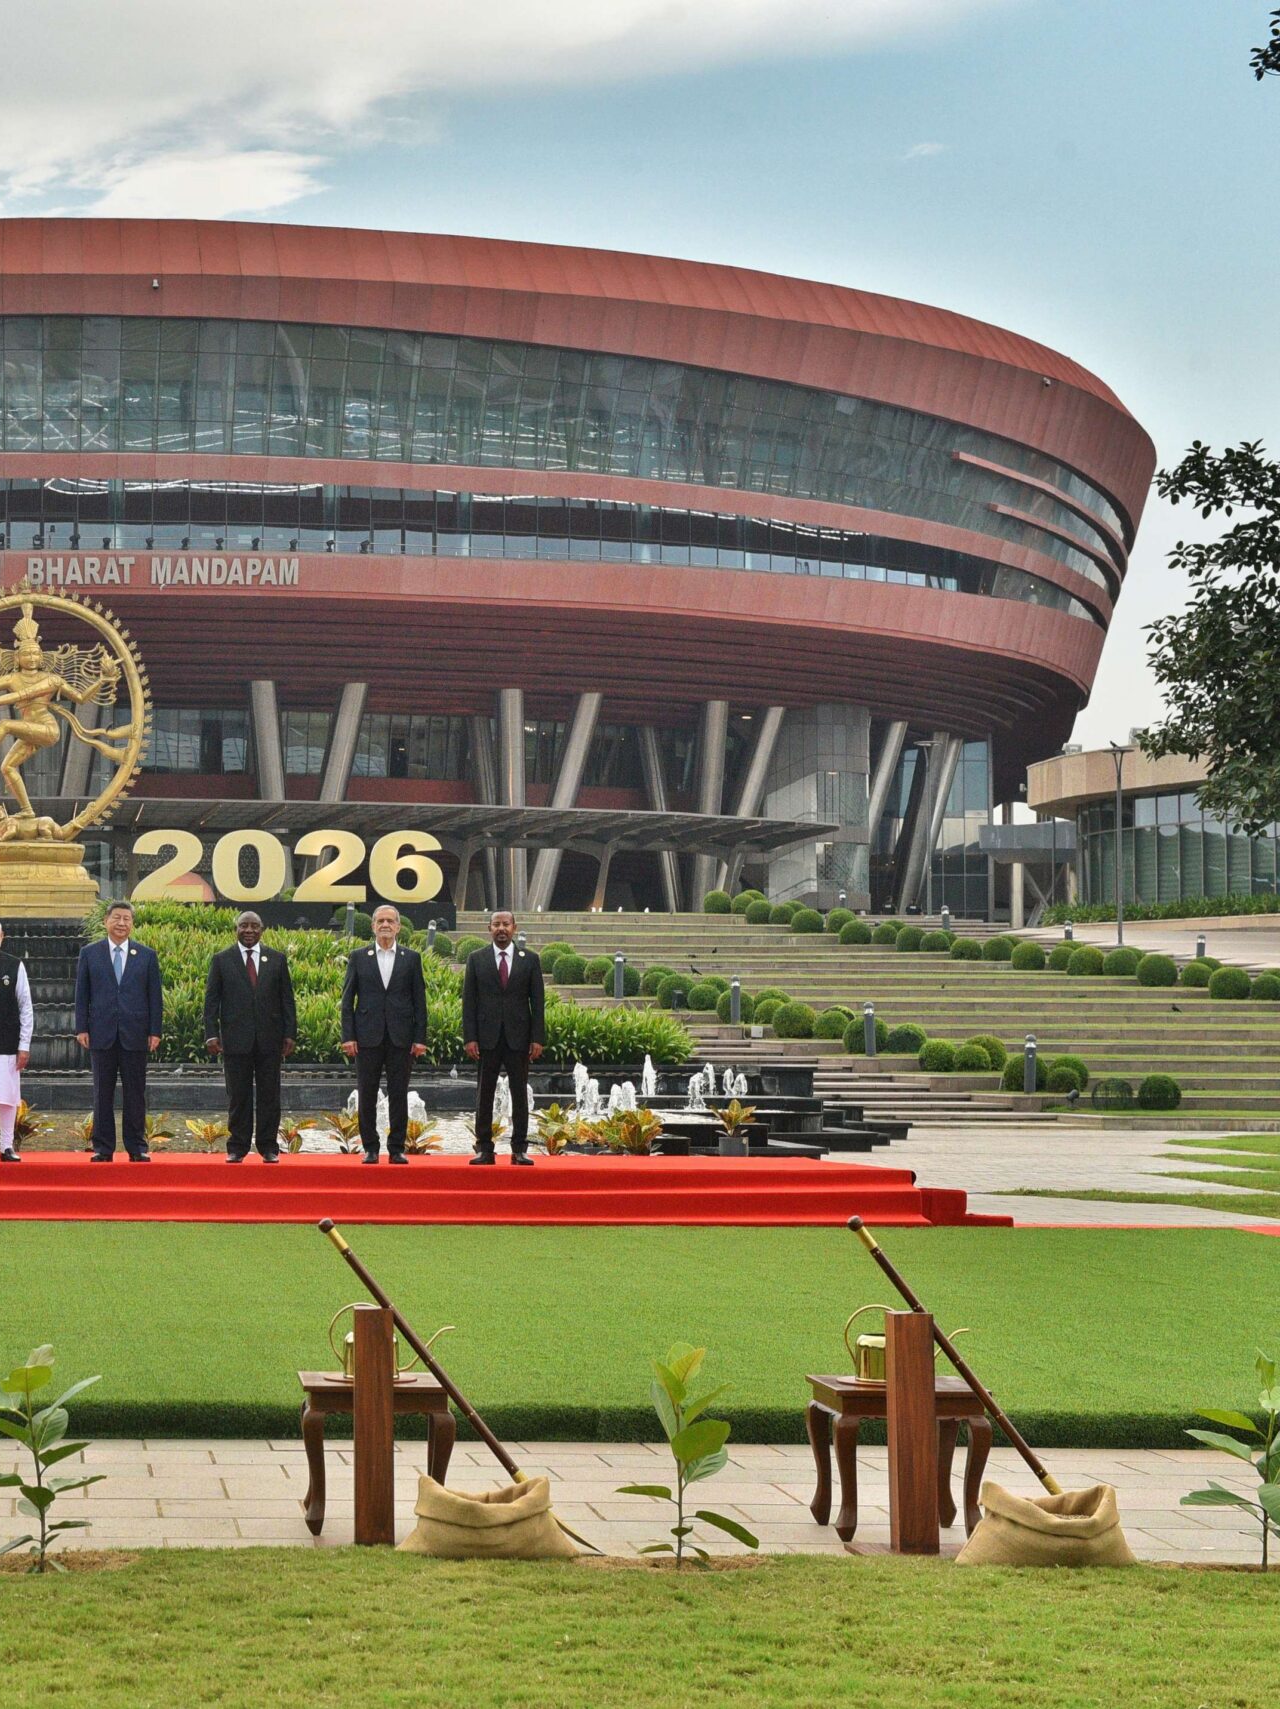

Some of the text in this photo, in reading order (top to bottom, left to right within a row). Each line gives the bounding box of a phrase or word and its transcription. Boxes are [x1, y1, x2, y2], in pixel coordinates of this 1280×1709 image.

[27, 557, 299, 585] BHARAT MANDAPAM
[130, 828, 444, 904] 2026
